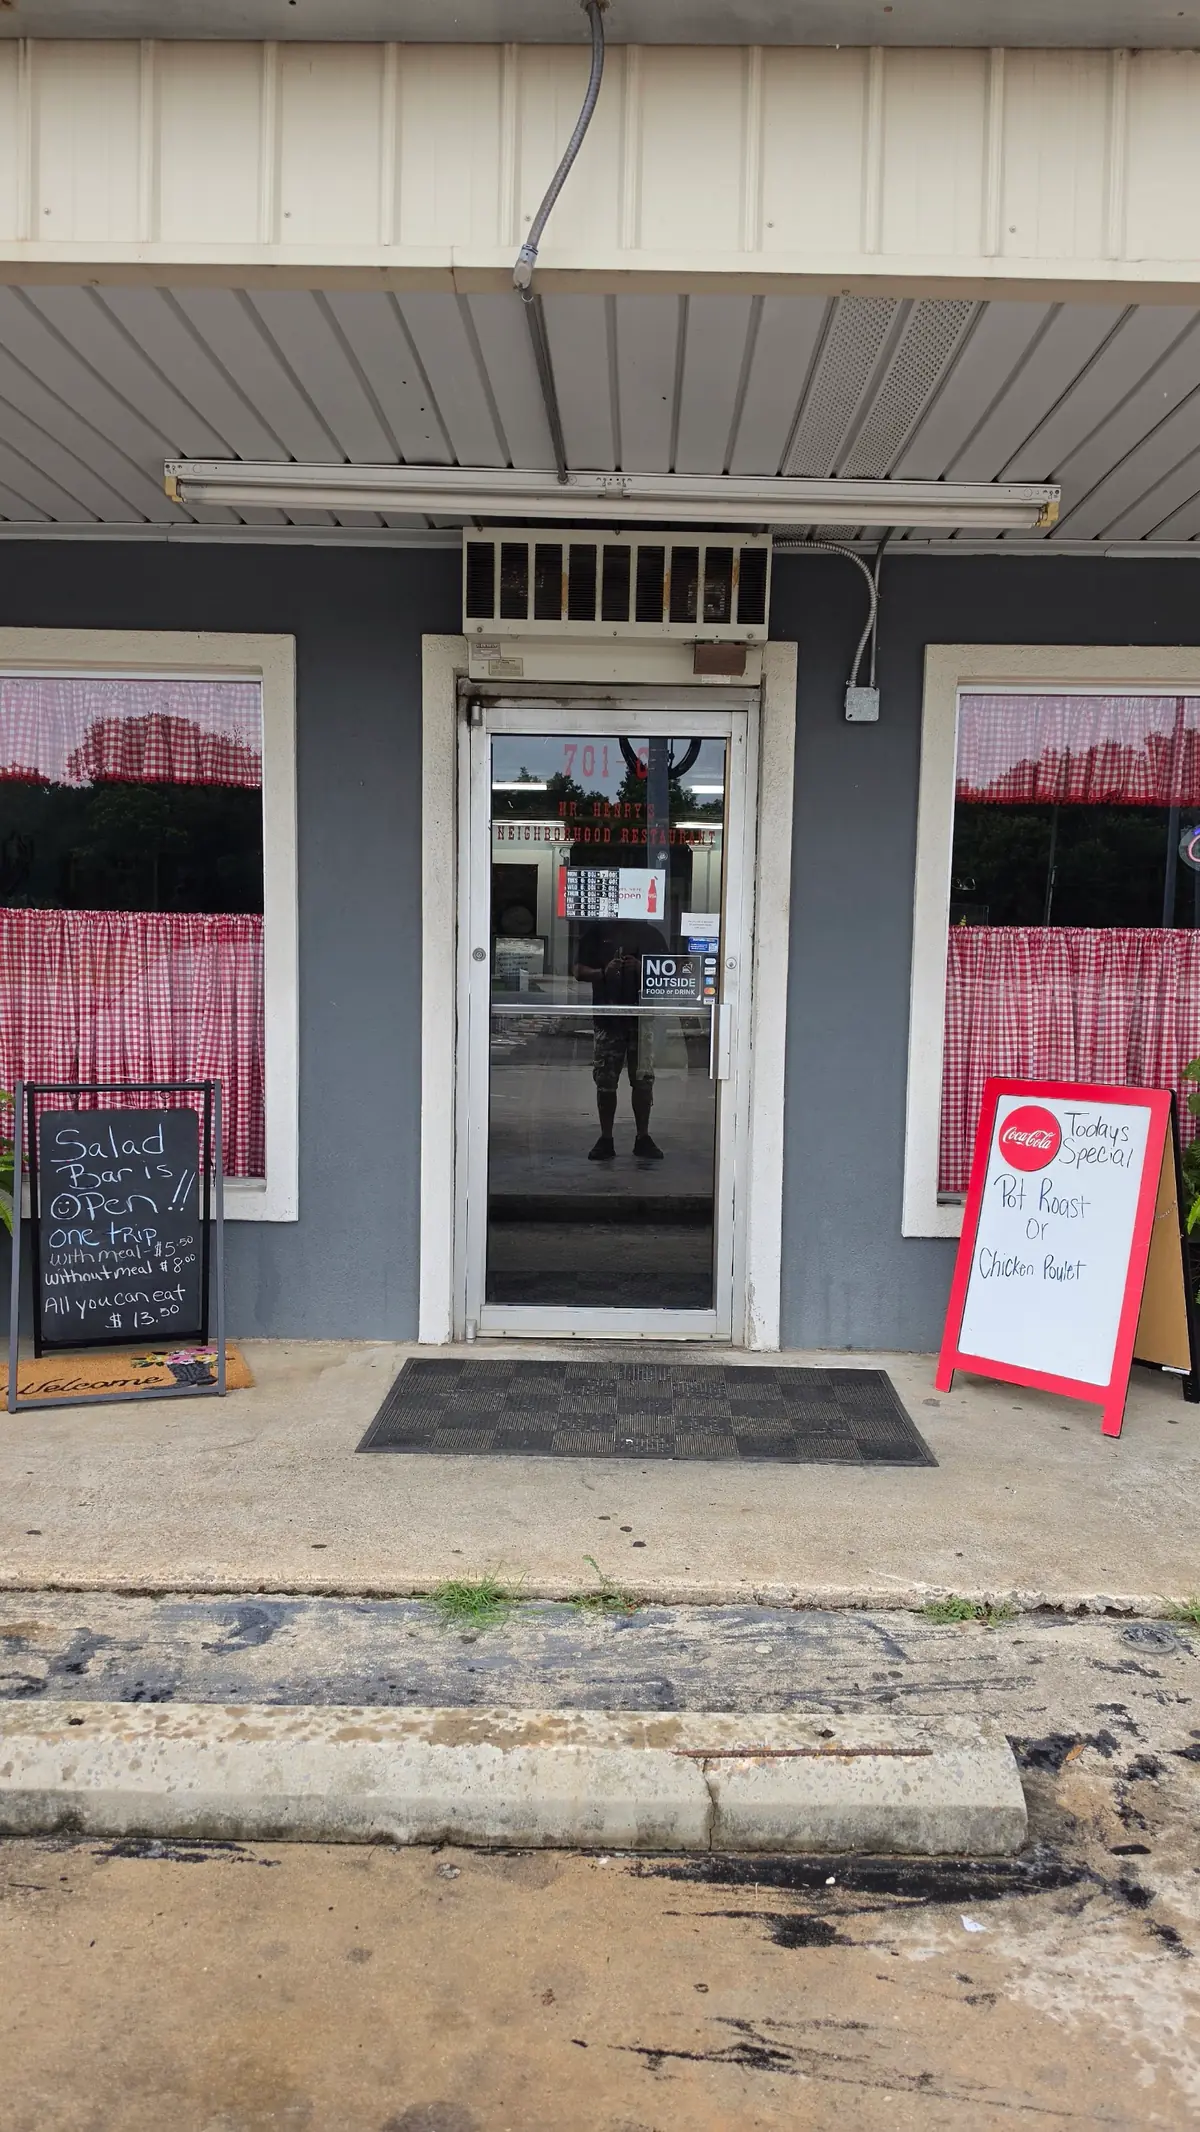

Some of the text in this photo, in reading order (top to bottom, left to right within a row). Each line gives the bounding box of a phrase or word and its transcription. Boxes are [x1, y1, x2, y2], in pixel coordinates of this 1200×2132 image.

[497, 825, 716, 846] NEIGHBORHOOD RESTAURANT
[646, 960, 677, 976] NO
[646, 977, 696, 987] OUTSIDE
[1002, 1126, 1055, 1149] Coca-Cola
[1064, 1112, 1130, 1147] Todays
[50, 1123, 164, 1162] Salad
[1058, 1137, 1133, 1169] Special
[56, 1159, 173, 1190] Bar is
[993, 1173, 1091, 1218] Pot Roast
[49, 1228, 100, 1248] one
[1026, 1217, 1049, 1240] Or
[50, 1248, 95, 1266] with
[979, 1247, 1087, 1282] Chicken Poulet
[45, 1265, 111, 1285] without
[114, 1260, 152, 1279] meal
[44, 1283, 186, 1320] All you can eat
